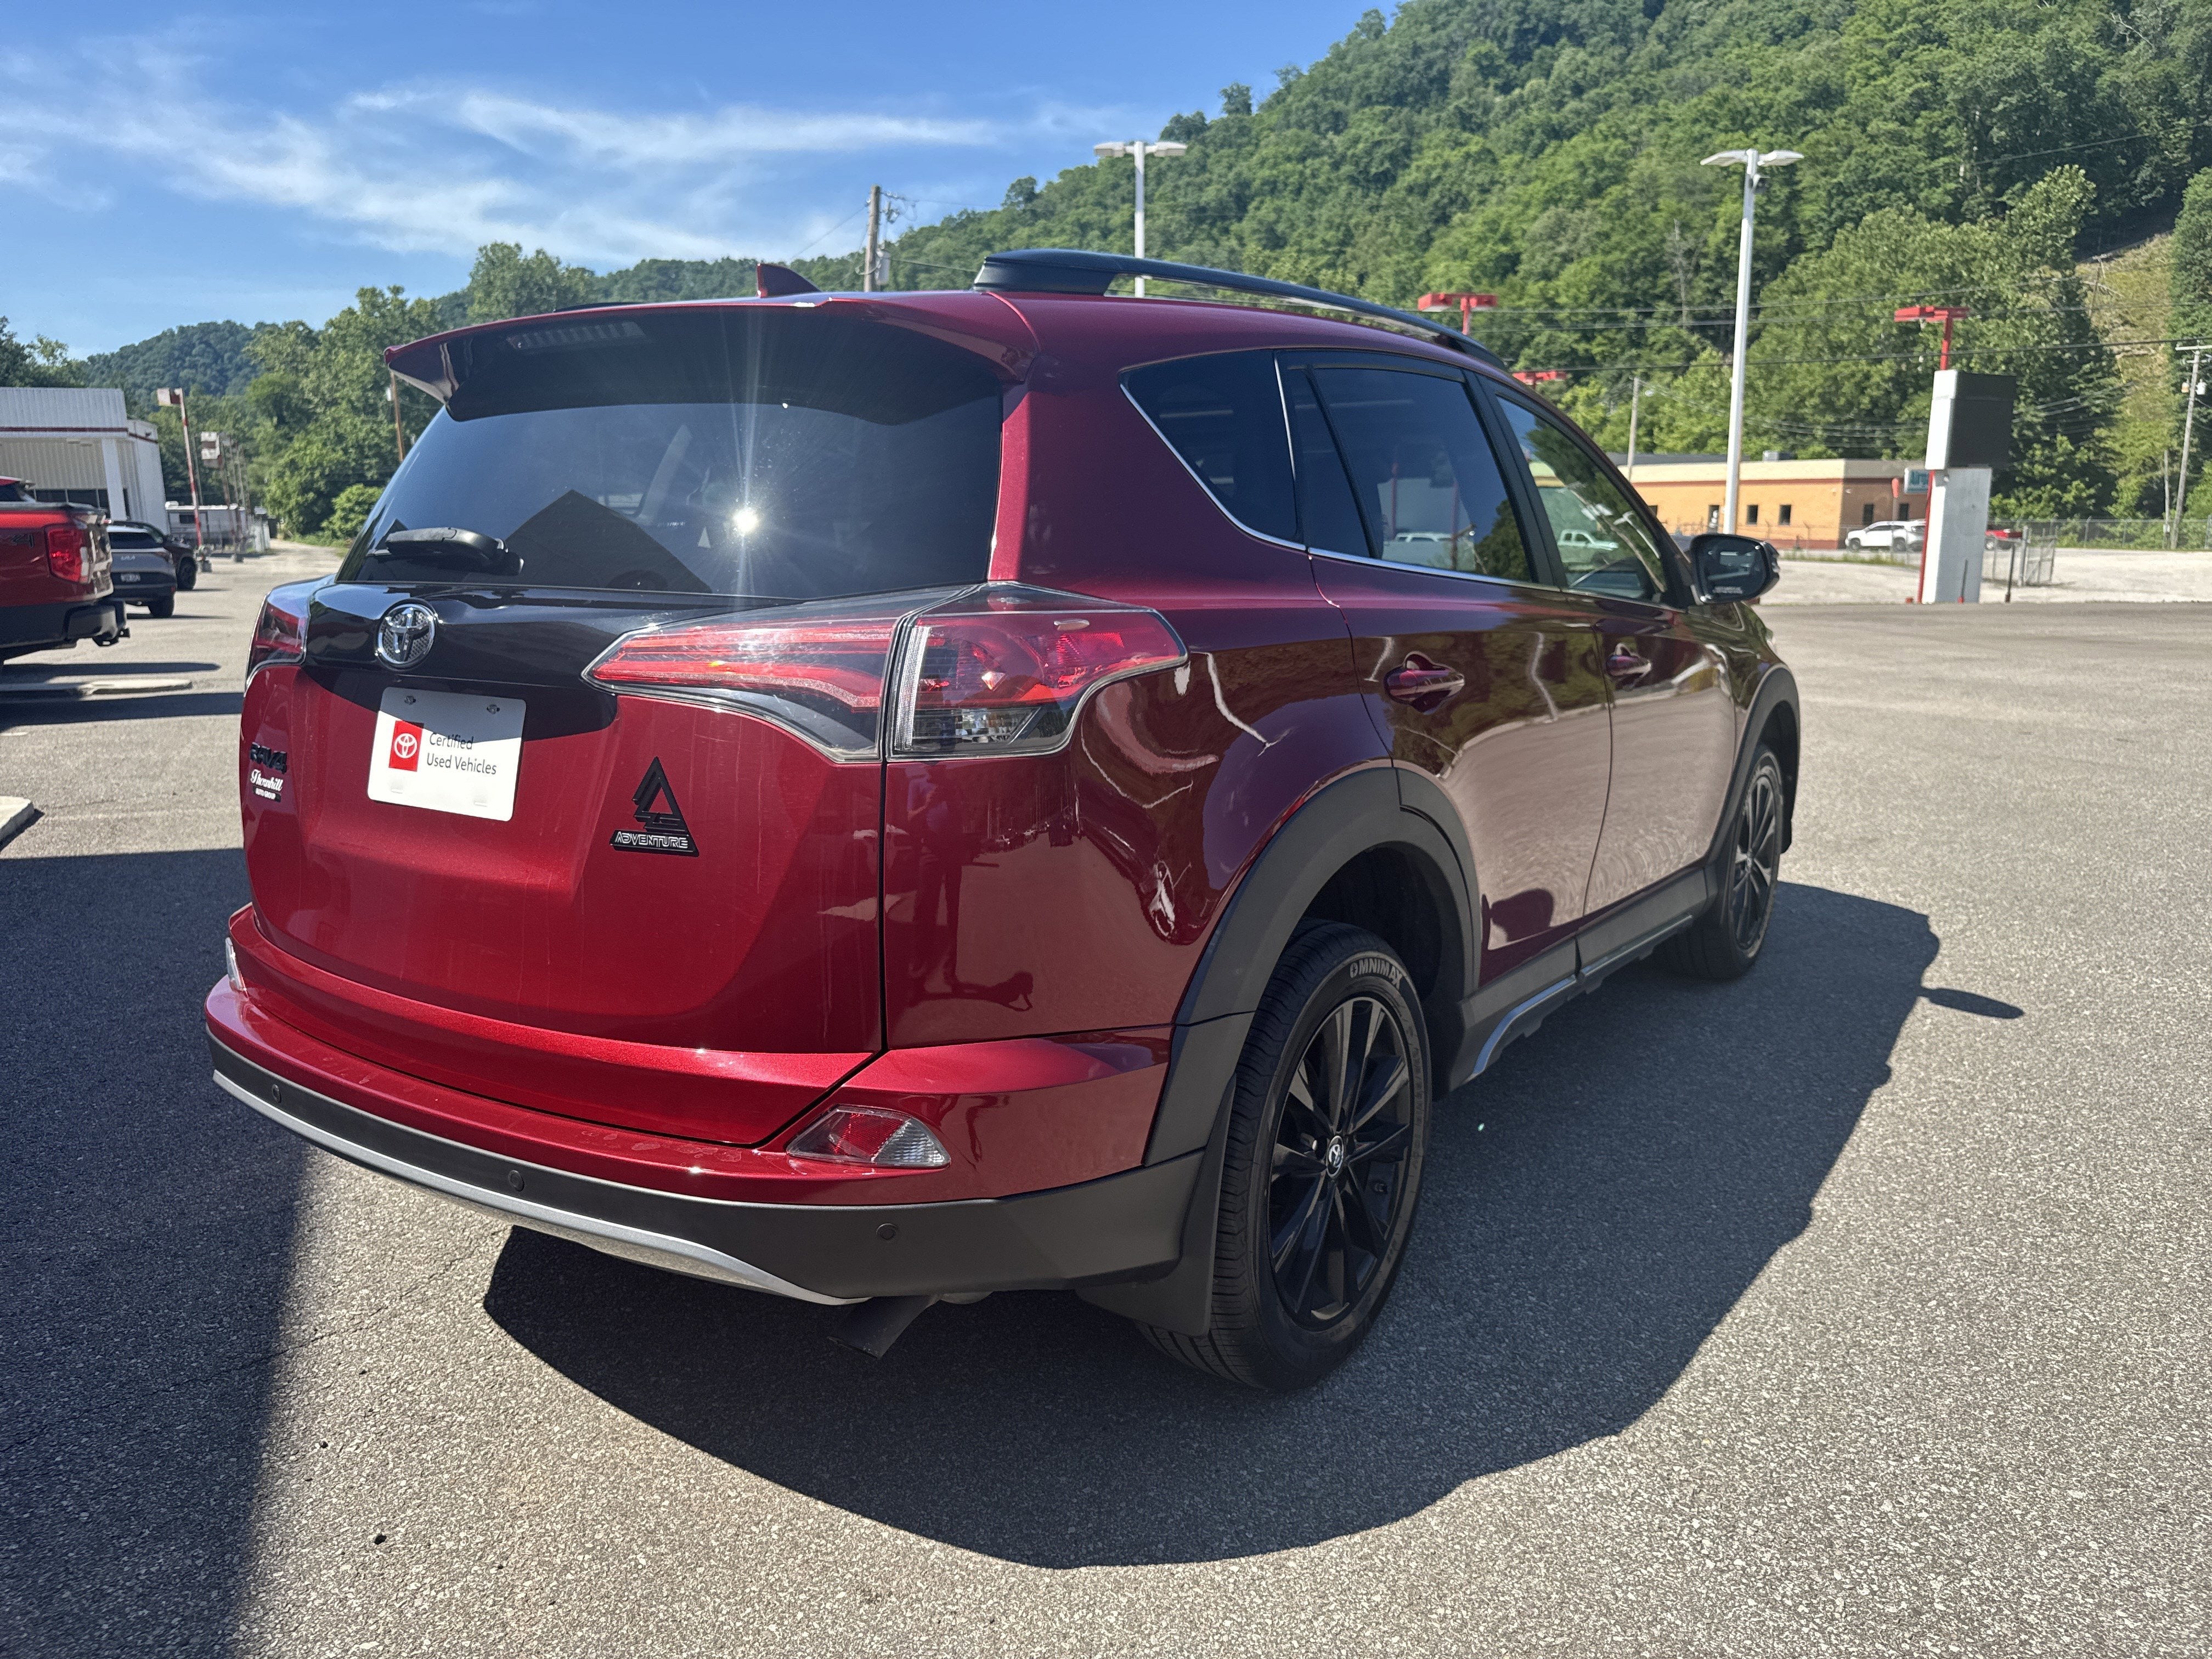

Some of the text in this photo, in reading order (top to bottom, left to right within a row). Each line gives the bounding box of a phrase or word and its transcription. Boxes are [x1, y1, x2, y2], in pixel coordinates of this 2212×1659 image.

[429, 733, 473, 750] Certified
[250, 742, 287, 774] RAV4
[427, 752, 496, 775] Used Vehicles
[250, 769, 284, 791] Thornhill
[614, 831, 688, 849] ADVENTURE
[1350, 958, 1403, 987] OMNIMAX
